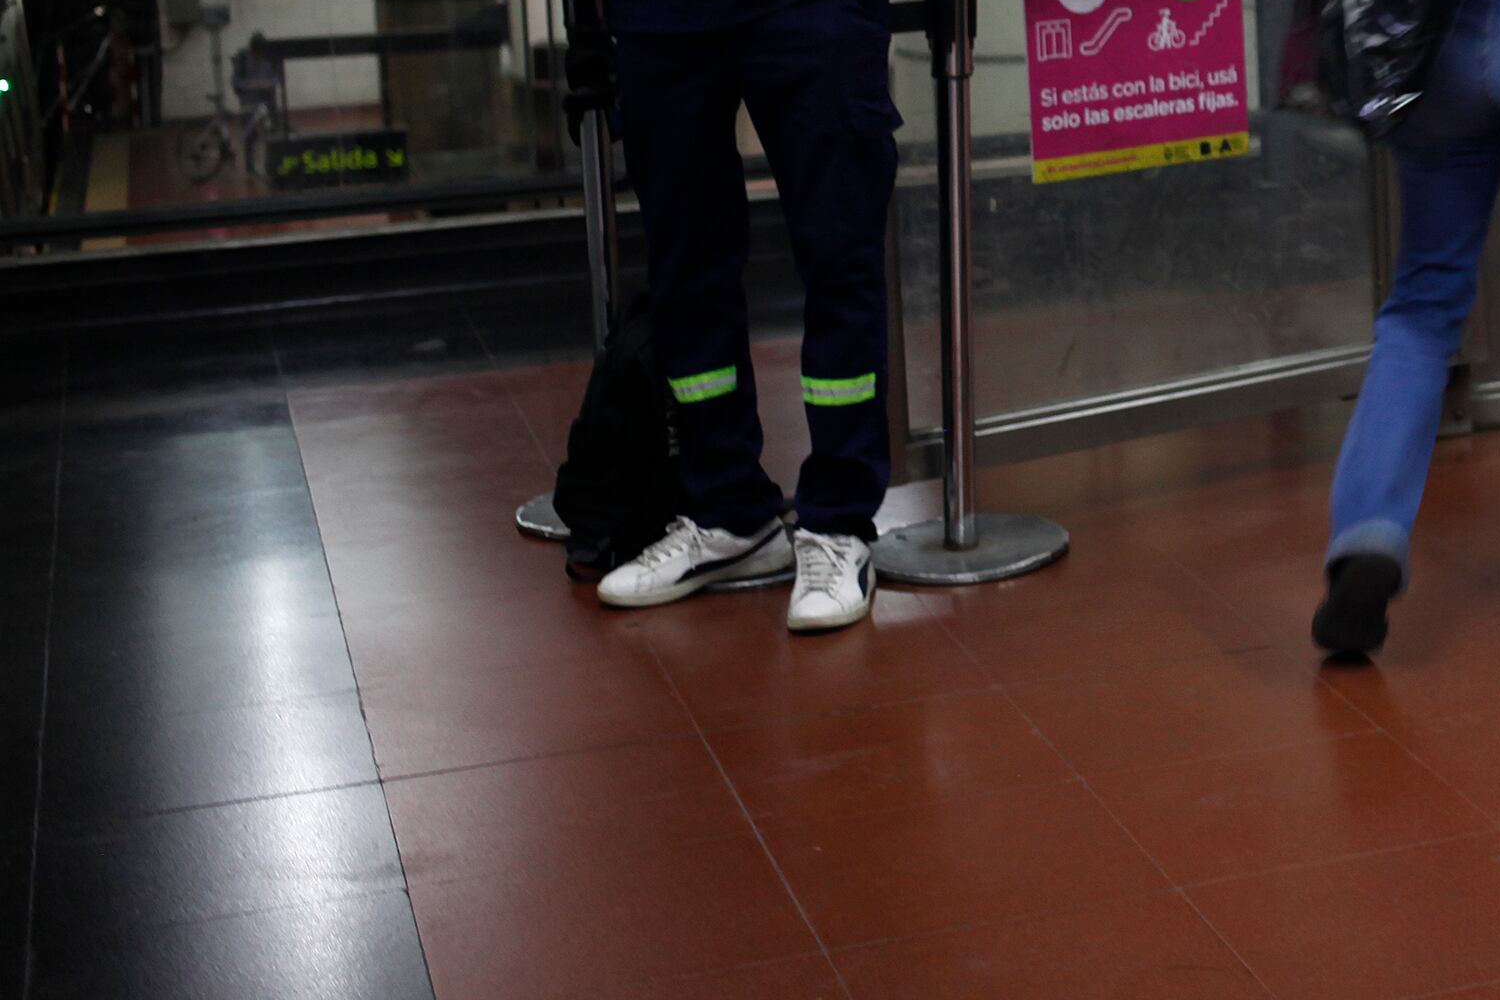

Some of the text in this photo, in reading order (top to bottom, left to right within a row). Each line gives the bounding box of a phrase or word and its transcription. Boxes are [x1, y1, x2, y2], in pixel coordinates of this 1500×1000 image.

[1040, 65, 1238, 107] Si estás con la bici, usá
[1041, 91, 1239, 132] solo las escaleras fijas.
[302, 148, 379, 175] Salida
